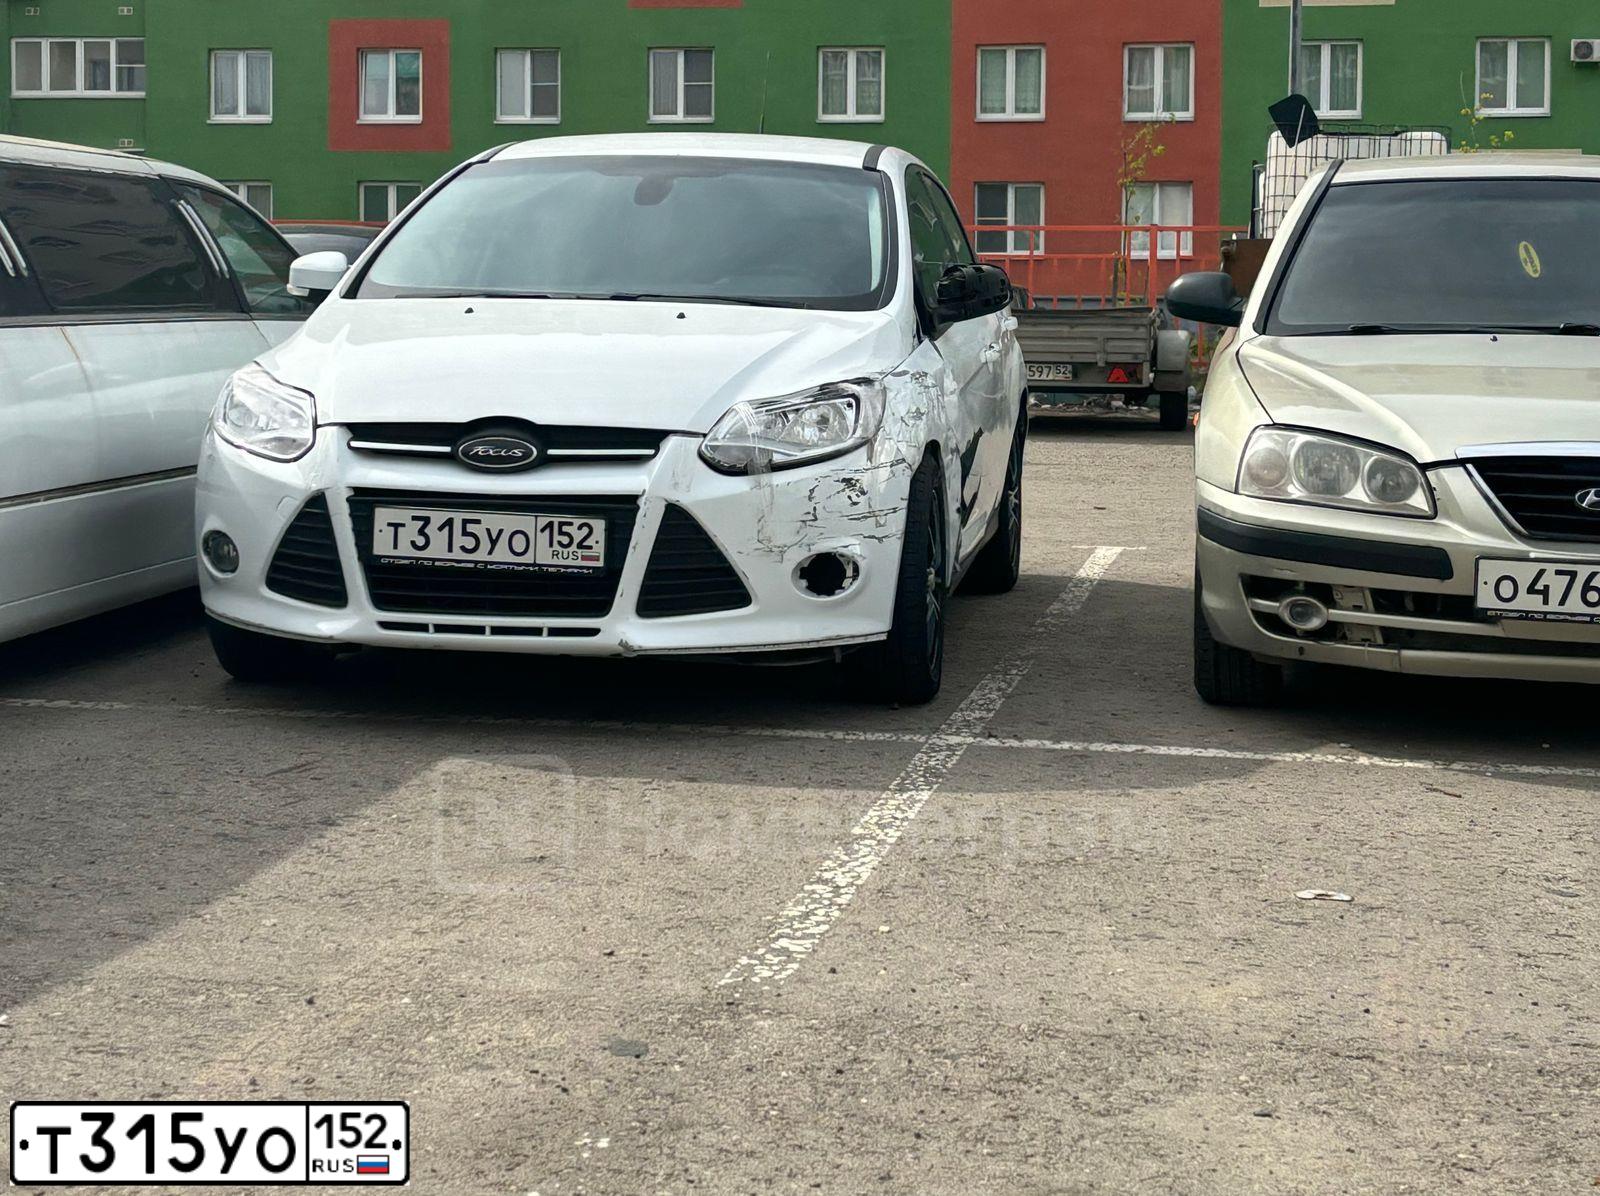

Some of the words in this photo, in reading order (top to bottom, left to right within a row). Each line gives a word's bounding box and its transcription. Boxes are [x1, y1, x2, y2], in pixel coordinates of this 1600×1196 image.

[1028, 365, 1052, 378] 597
[1055, 365, 1068, 375] 52
[387, 515, 530, 557] Т315УО
[540, 520, 594, 550] 152
[552, 550, 580, 561] RUS
